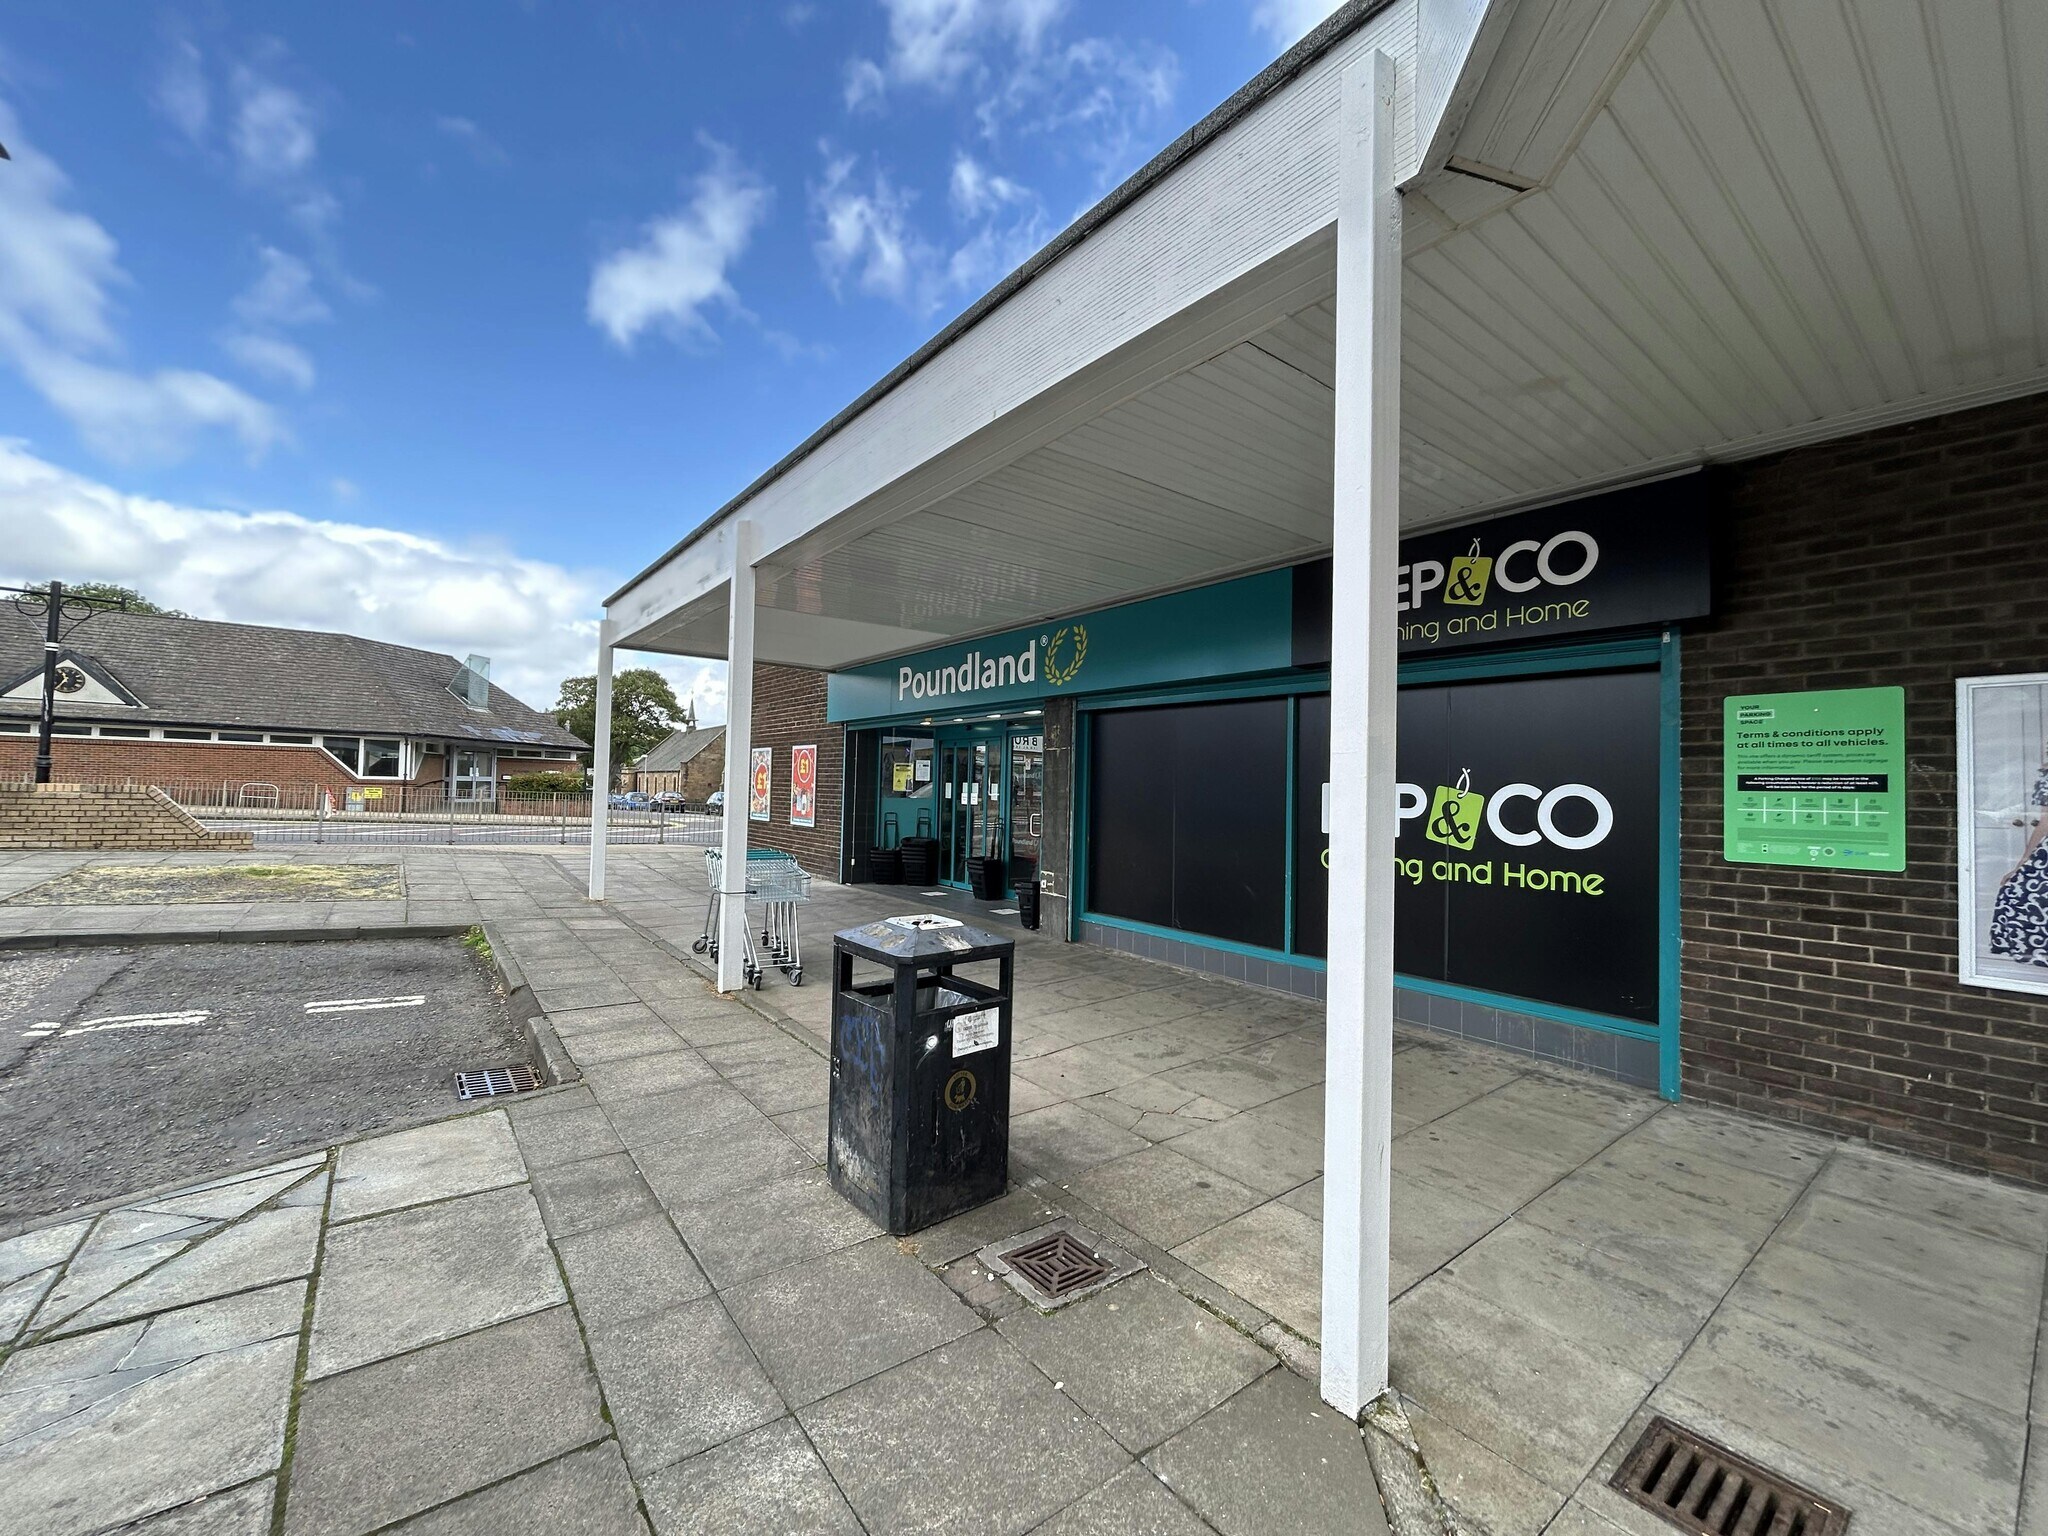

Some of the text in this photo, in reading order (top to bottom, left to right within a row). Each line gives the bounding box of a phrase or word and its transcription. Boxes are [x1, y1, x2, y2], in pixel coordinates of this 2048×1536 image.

[1447, 610, 1497, 635] and
[1506, 599, 1590, 627] Home
[1782, 729, 1844, 738] conditions
[1848, 728, 1884, 736] apply
[1834, 738, 1888, 746] vehicles.
[800, 759, 809, 774] £1
[757, 772, 766, 790] £1
[1432, 861, 1492, 885] and
[1504, 862, 1605, 896] Home
